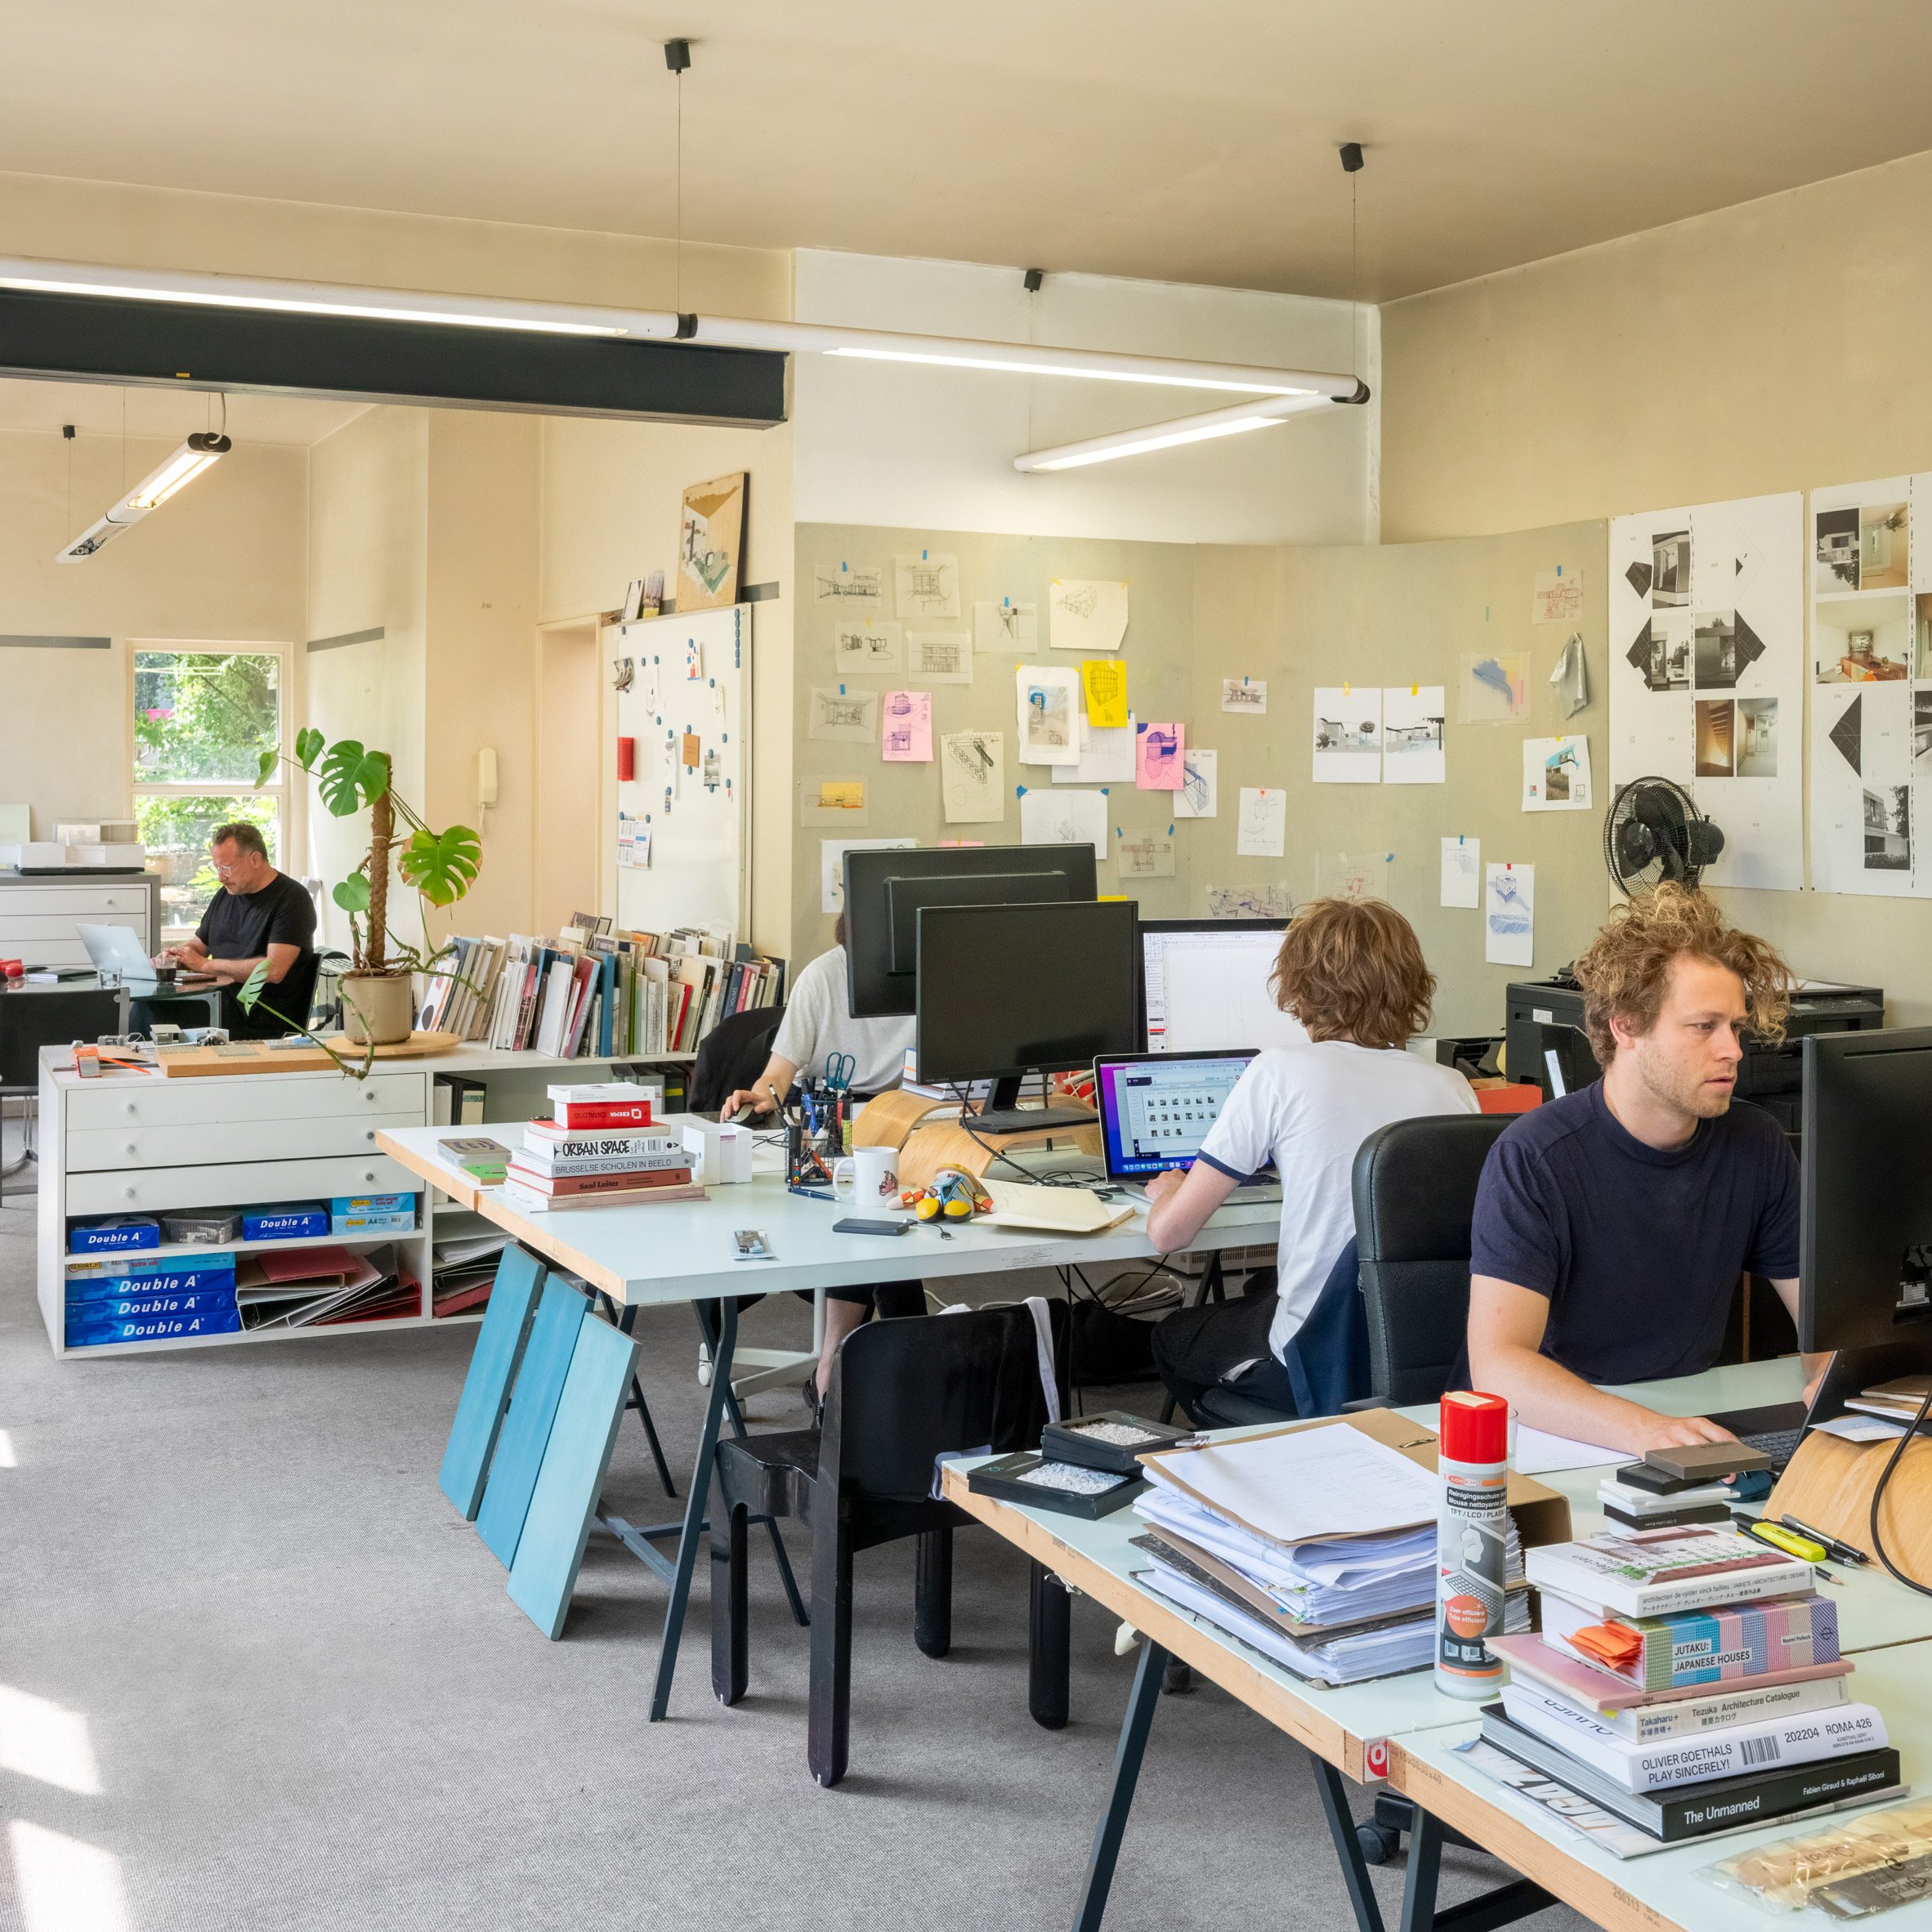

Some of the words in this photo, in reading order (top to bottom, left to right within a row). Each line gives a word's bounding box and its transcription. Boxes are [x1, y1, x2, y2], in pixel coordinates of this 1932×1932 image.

[562, 1142, 598, 1156] ORBAN
[600, 1139, 630, 1155] SPACE
[555, 1163, 598, 1174] BRUSSELSE
[601, 1161, 637, 1172] SCHOLEN
[648, 1158, 672, 1168] BEELD
[579, 1182, 596, 1190] Saul
[597, 1180, 619, 1188] Leiter
[259, 1218, 297, 1228] Double
[87, 1232, 127, 1244] Double
[119, 1276, 179, 1293] Double
[118, 1298, 178, 1315] Double
[123, 1320, 182, 1336] Double
[1448, 1488, 1500, 1501] Reinigingsschuim
[1448, 1496, 1469, 1506] Mouse
[1469, 1501, 1500, 1509] nettoyante
[1450, 1508, 1463, 1516] TFT
[1643, 1593, 1673, 1604] architecten
[1681, 1588, 1698, 1599] vylder
[1698, 1585, 1713, 1595] vinck
[1713, 1583, 1730, 1593] taillieu
[1754, 1574, 1787, 1586] ARCHITECTURE
[1790, 1571, 1806, 1579] DESIRE
[1675, 1642, 1709, 1657] JUTAKU:
[1674, 1657, 1715, 1672] JAPANESE
[1717, 1651, 1751, 1664] HOUSES
[1640, 1715, 1673, 1727] Takaharu
[1692, 1706, 1717, 1718] Tezuka
[1721, 1697, 1764, 1712] Architecture
[1765, 1689, 1800, 1704] Catalogue
[1784, 1727, 1820, 1743] 202204
[1825, 1720, 1854, 1736] ROMA
[1855, 1717, 1872, 1730] 426
[1642, 1751, 1679, 1771] OLIVIER
[1680, 1743, 1733, 1764] GOETHALS
[1648, 1769, 1674, 1784] PLAY
[1675, 1759, 1731, 1779] SINCERELY!
[1803, 1787, 1821, 1796] Fabien
[1822, 1782, 1840, 1792] Giraud
[1846, 1775, 1867, 1787] Raphaël
[1867, 1771, 1885, 1782] Siboni
[1684, 1810, 1703, 1825] The
[1706, 1796, 1760, 1819] Unmanned
